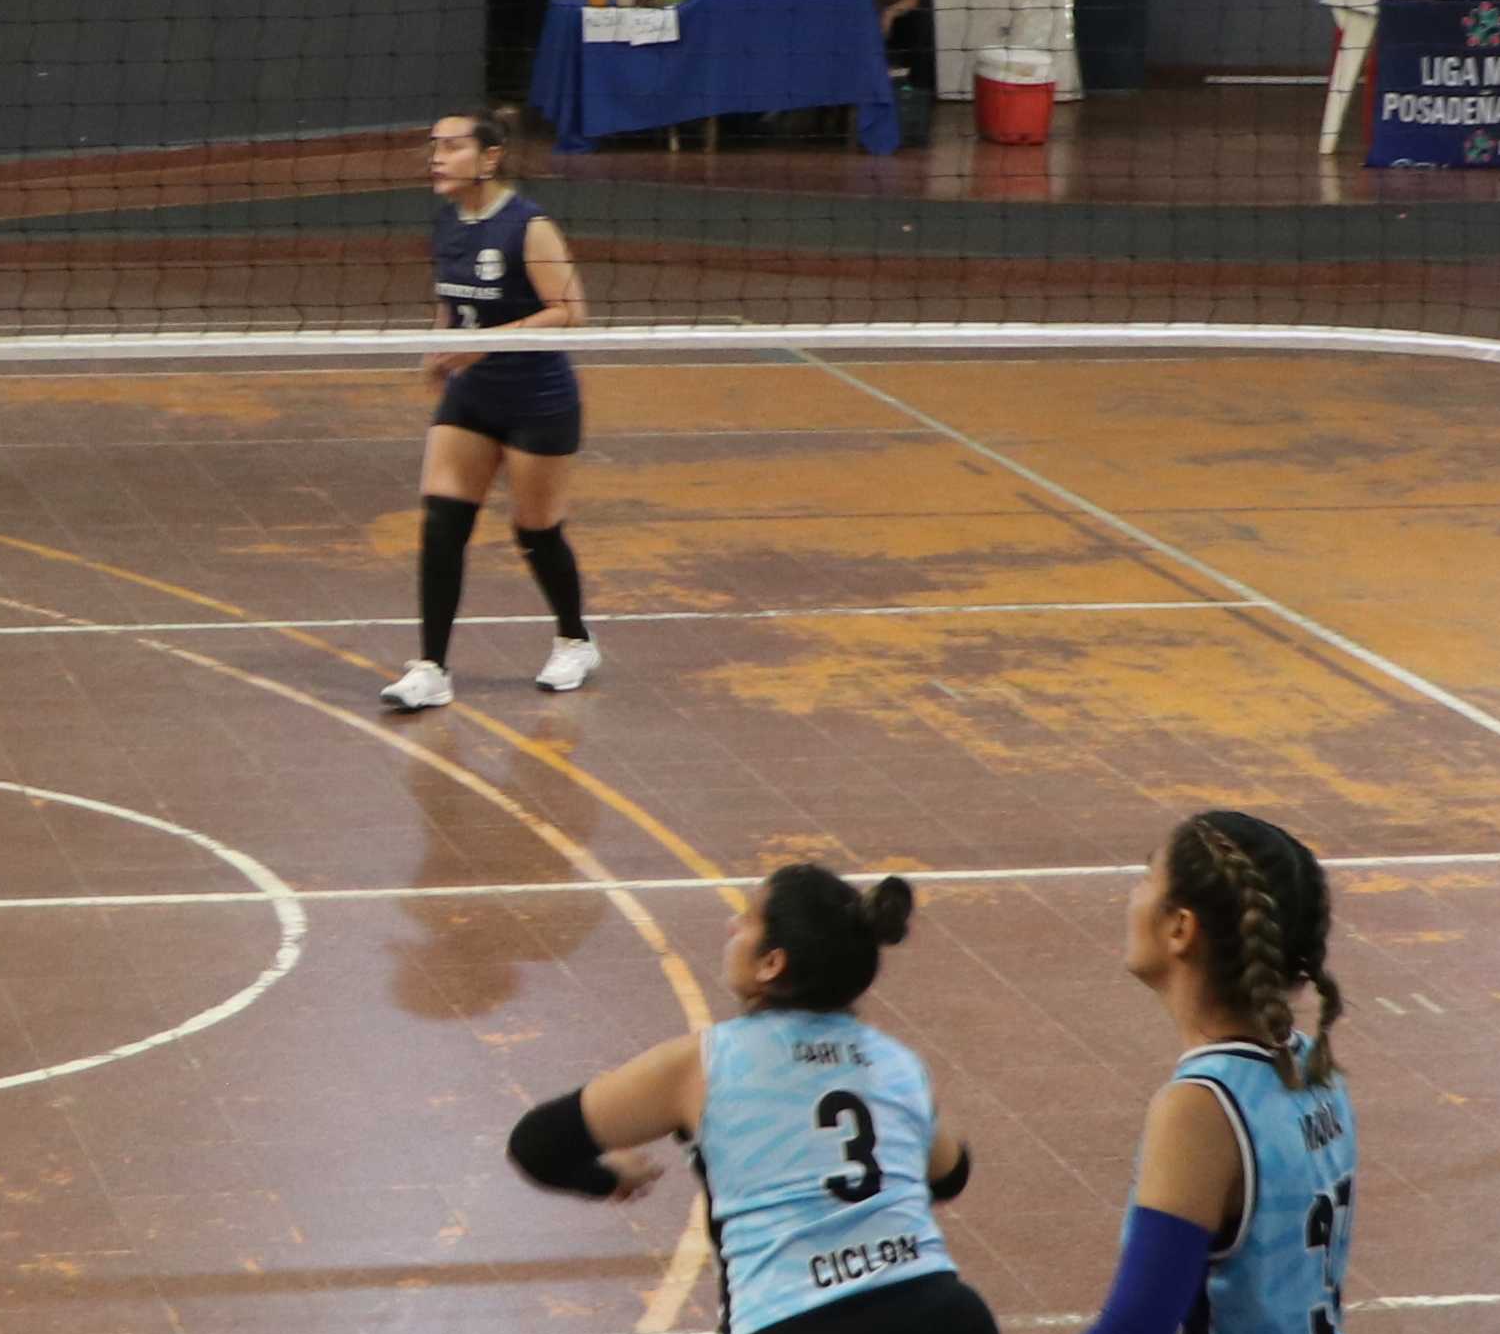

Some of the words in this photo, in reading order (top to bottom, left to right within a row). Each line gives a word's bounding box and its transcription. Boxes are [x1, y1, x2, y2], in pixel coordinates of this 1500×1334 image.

[1420, 55, 1479, 87] LIGA
[815, 1089, 883, 1203] 3
[810, 1234, 920, 1289] CICLON
